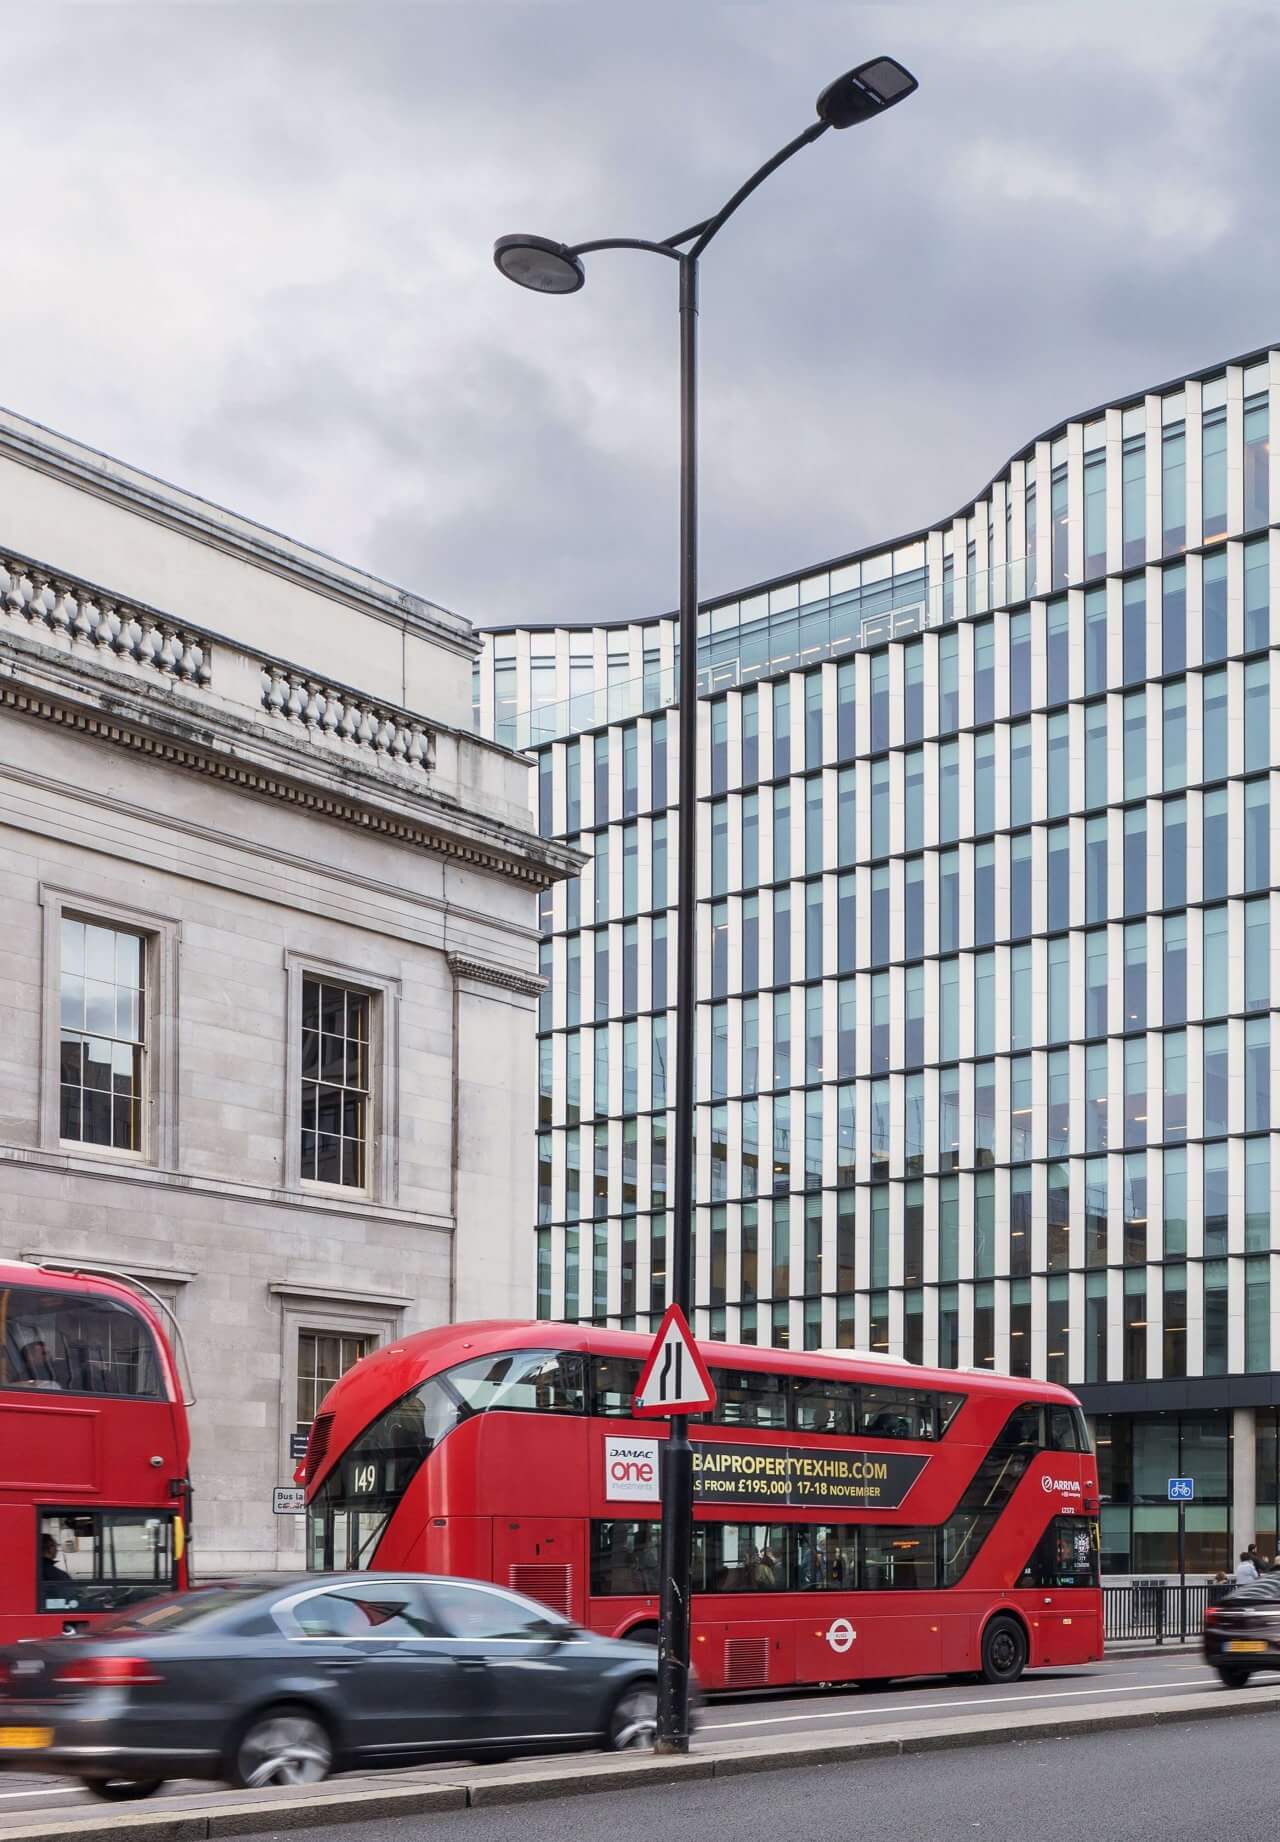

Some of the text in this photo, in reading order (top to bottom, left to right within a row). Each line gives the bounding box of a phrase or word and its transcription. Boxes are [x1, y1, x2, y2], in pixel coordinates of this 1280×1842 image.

[609, 1449, 654, 1459] DAMAC
[611, 1461, 653, 1482] one
[692, 1453, 888, 1480] BAIPROPERTYEXHIB.COM
[354, 1465, 376, 1493] 149
[1053, 1480, 1080, 1491] ARRIVA
[277, 1492, 304, 1500] Bus la
[704, 1481, 736, 1493] FROM
[738, 1480, 793, 1495] £195,000
[796, 1482, 828, 1496] 17-18
[829, 1486, 881, 1498] NOVEMBER
